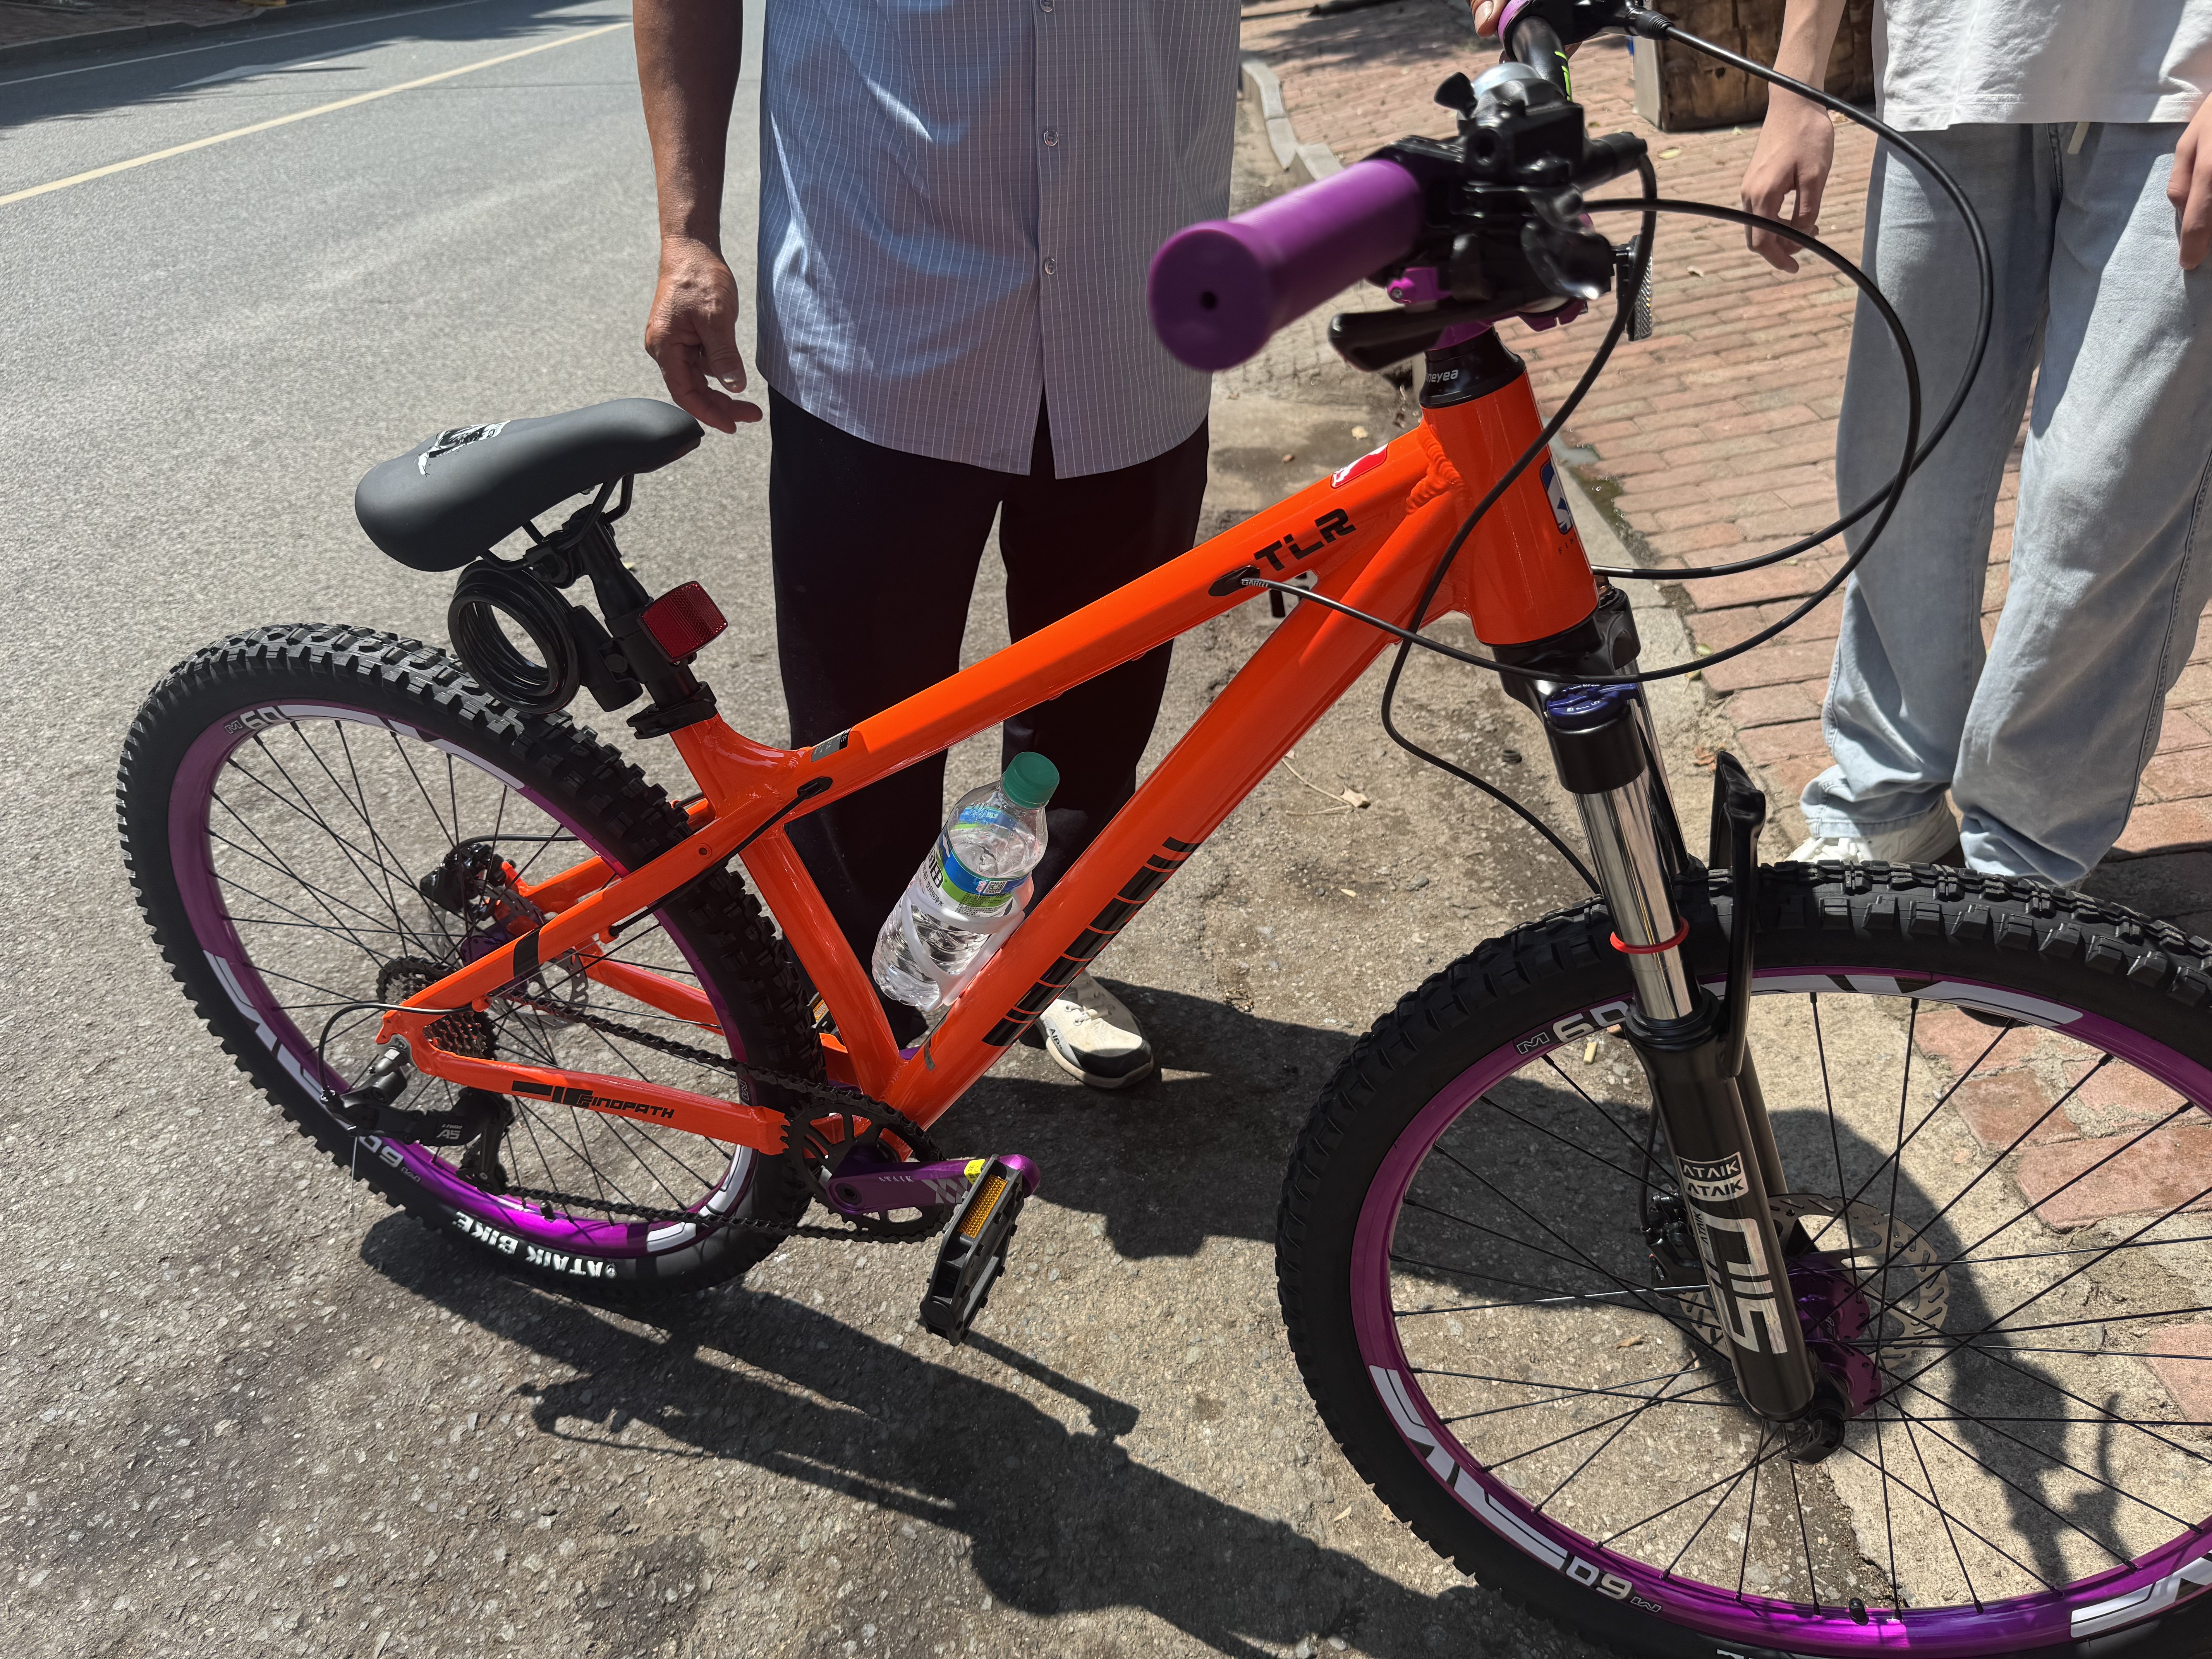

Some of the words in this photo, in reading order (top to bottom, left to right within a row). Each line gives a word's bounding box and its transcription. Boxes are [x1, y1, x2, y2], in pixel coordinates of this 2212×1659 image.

[1254, 508, 1356, 571] TLR
[579, 1094, 675, 1119] FINOPATH
[1683, 1160, 1739, 1178] ATAIK
[1688, 1178, 1744, 1197] ATAIK
[452, 1211, 519, 1255] BIKE
[525, 1245, 603, 1278] ATAIK
